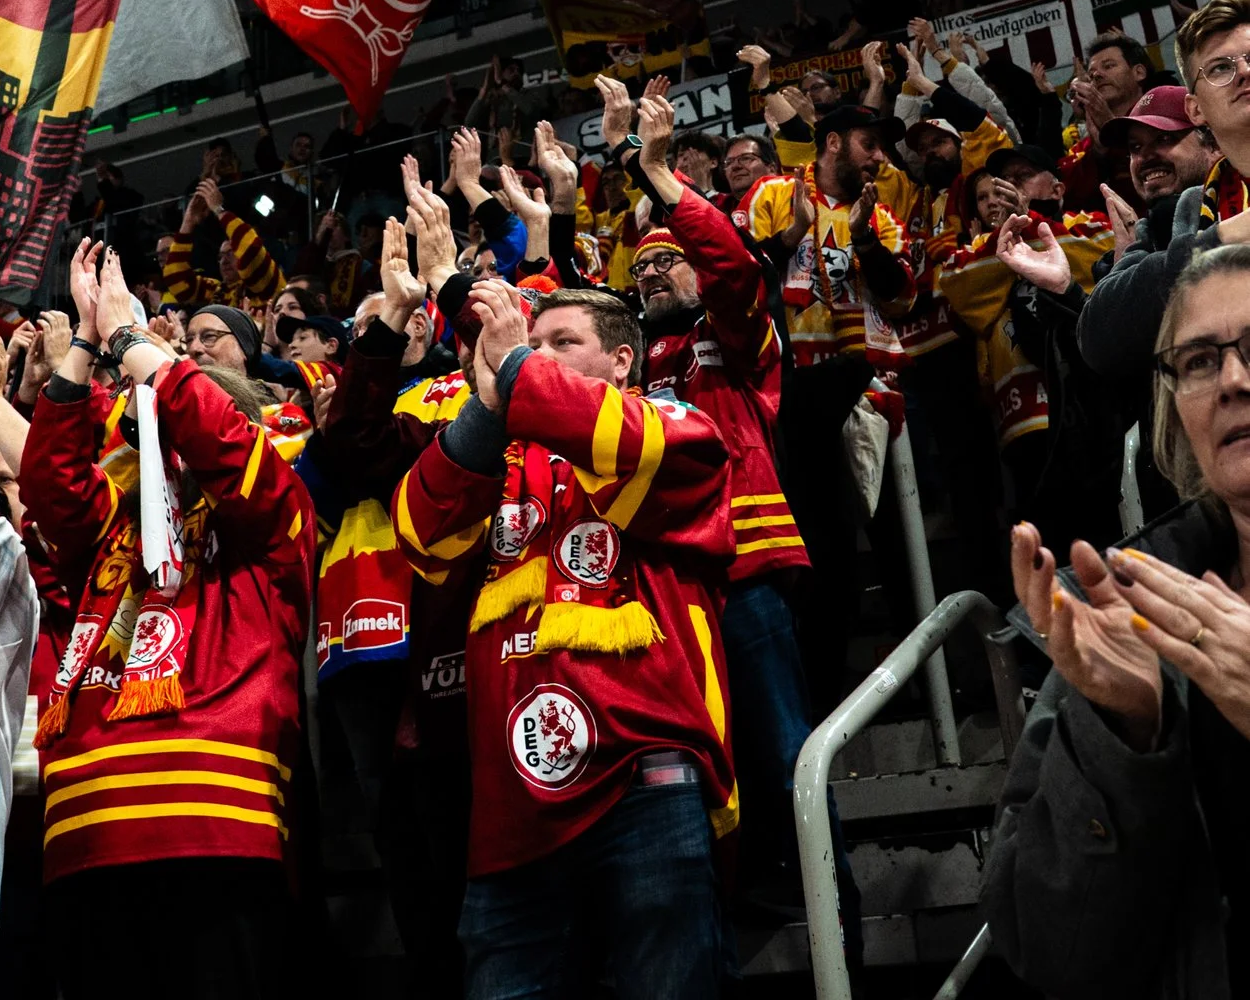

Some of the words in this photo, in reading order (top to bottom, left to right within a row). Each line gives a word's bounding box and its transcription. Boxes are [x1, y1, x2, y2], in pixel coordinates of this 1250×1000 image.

[496, 516, 513, 551] DEG
[568, 534, 582, 571] DEG
[345, 612, 402, 639] Zamek
[82, 665, 122, 690] ERK
[523, 717, 540, 767] DEG
